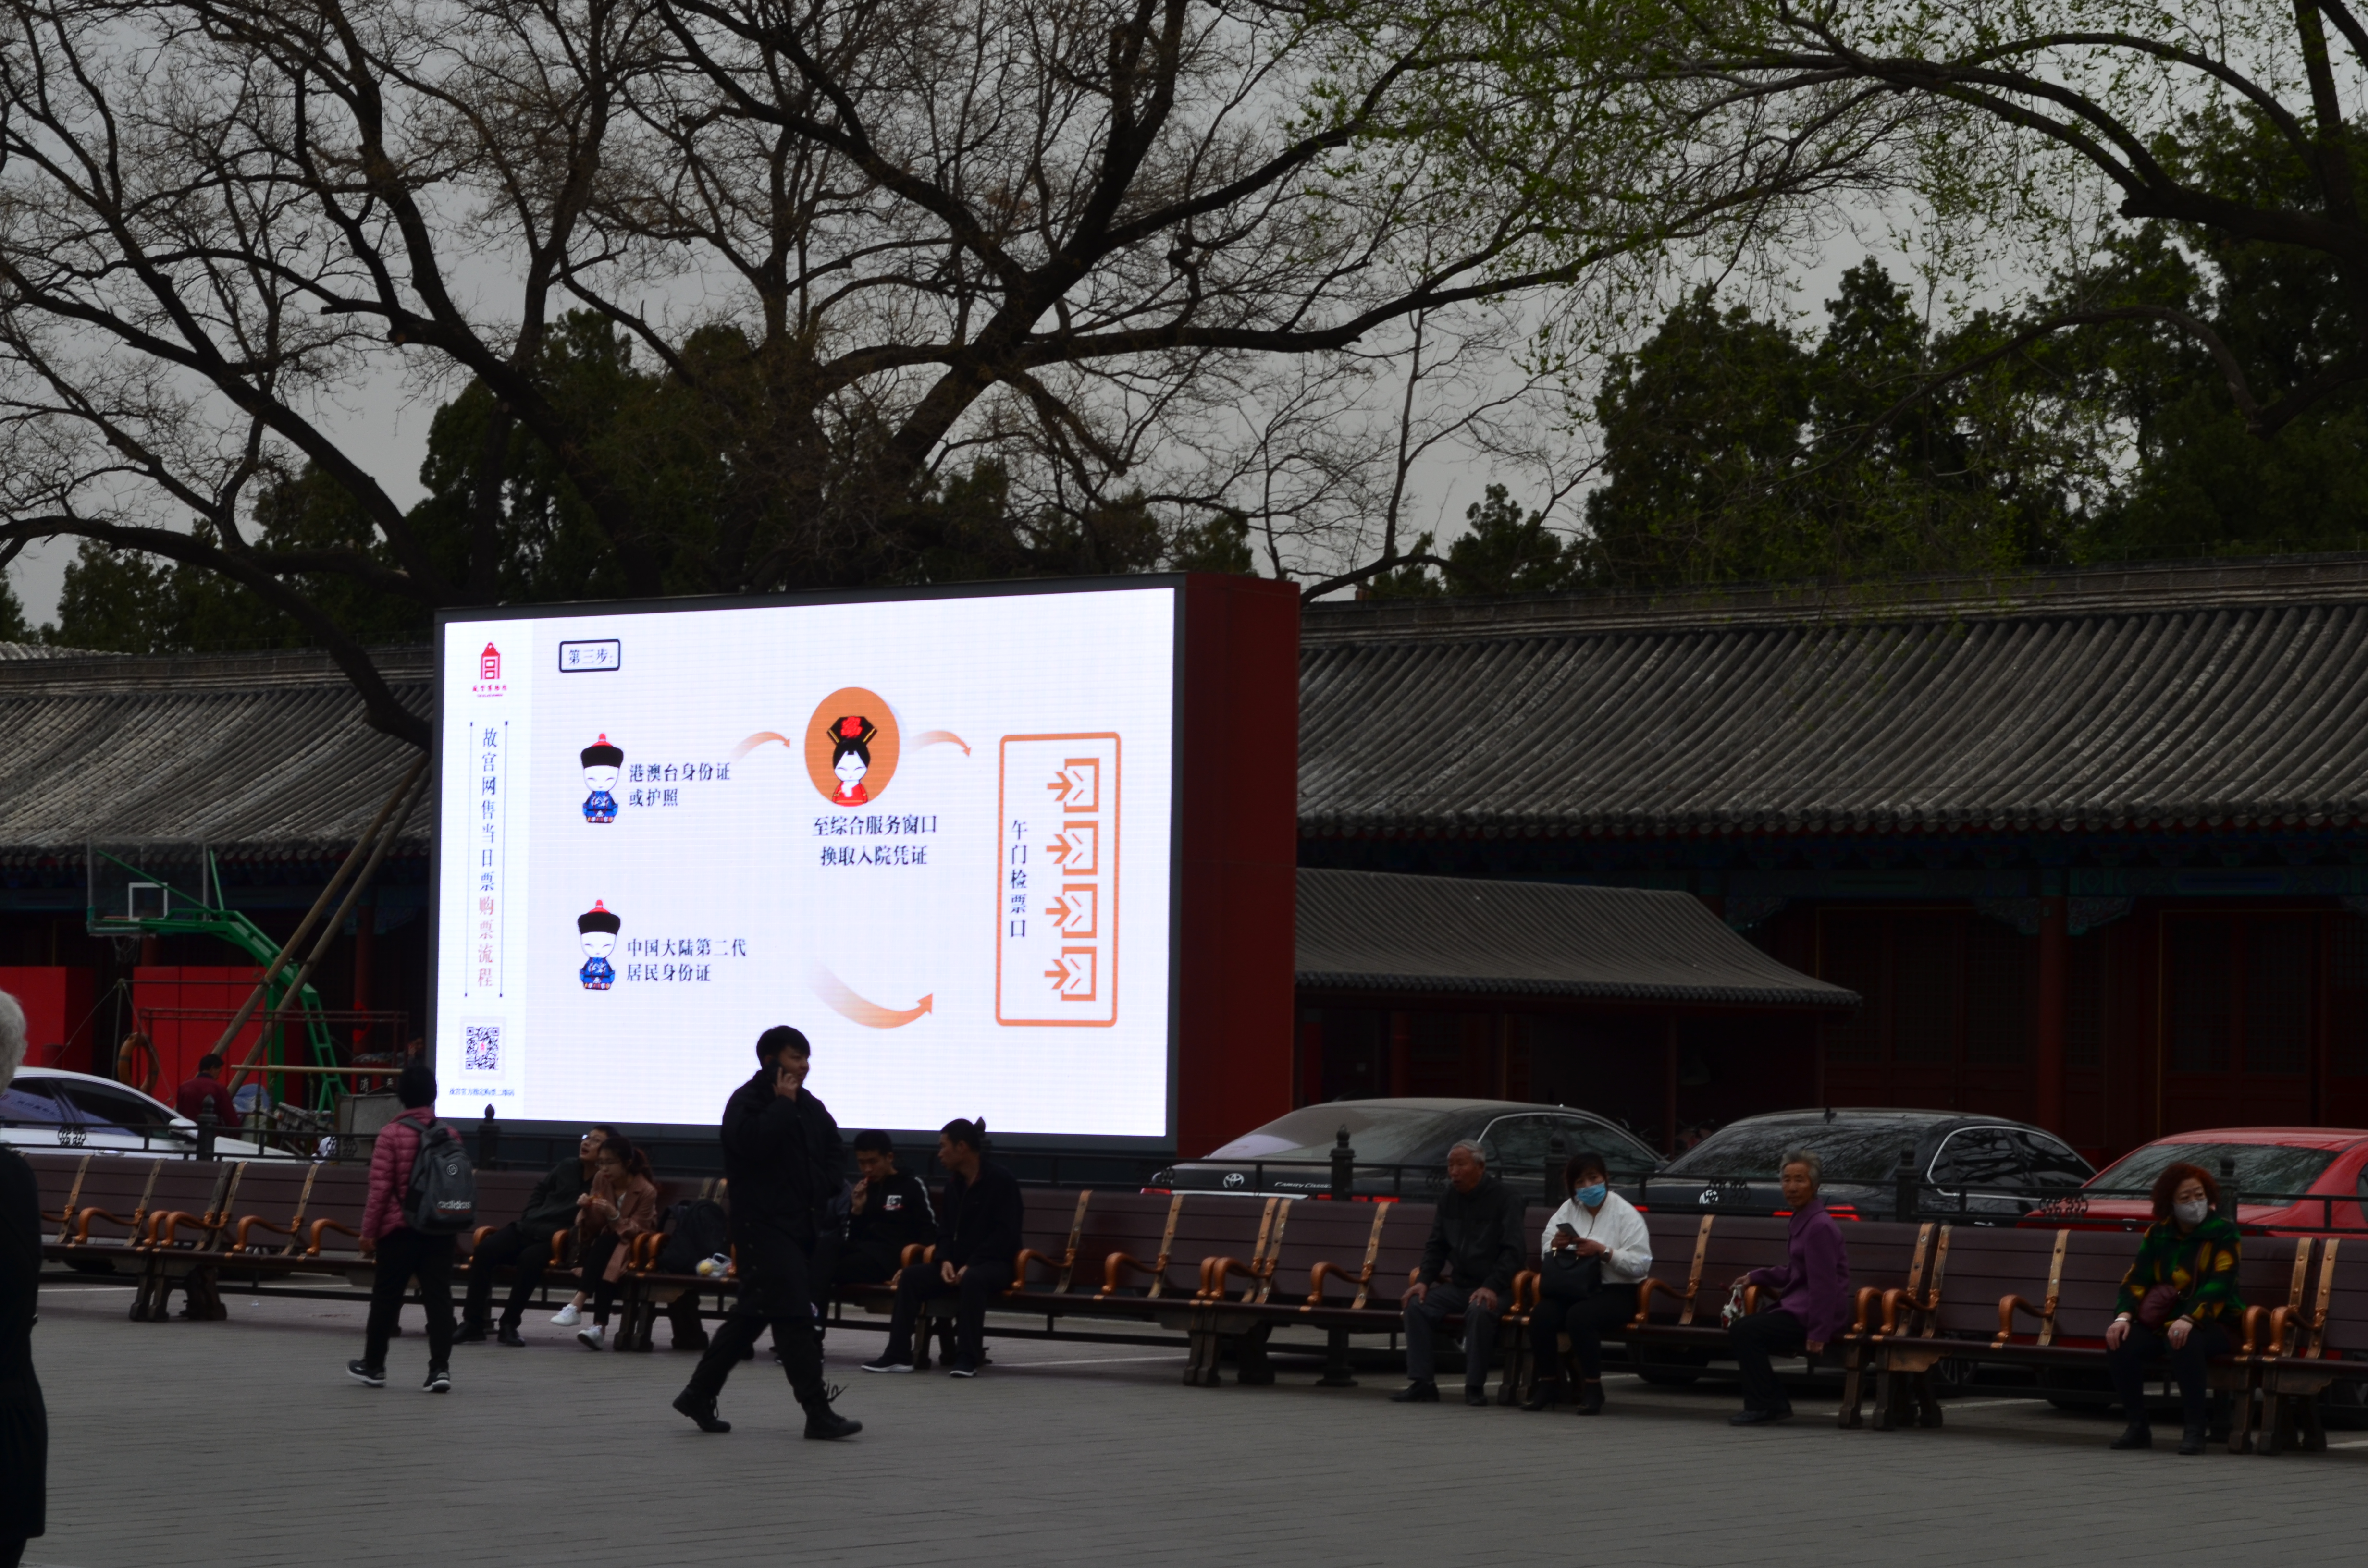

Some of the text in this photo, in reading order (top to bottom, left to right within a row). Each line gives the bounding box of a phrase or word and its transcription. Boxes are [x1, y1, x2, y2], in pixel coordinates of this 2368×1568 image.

[629, 762, 731, 783] 港澳台身份证
[629, 788, 678, 807] 或护照
[813, 814, 937, 836] 至综合服务窗口
[478, 728, 497, 988] 故宫网售当日票购票流程
[820, 845, 927, 866] 换取入院凭证
[1010, 820, 1027, 938] 午门检票口
[627, 938, 747, 957] 中国大陆第二代
[627, 963, 711, 982] 居民身份证
[437, 1200, 471, 1209] adidas
